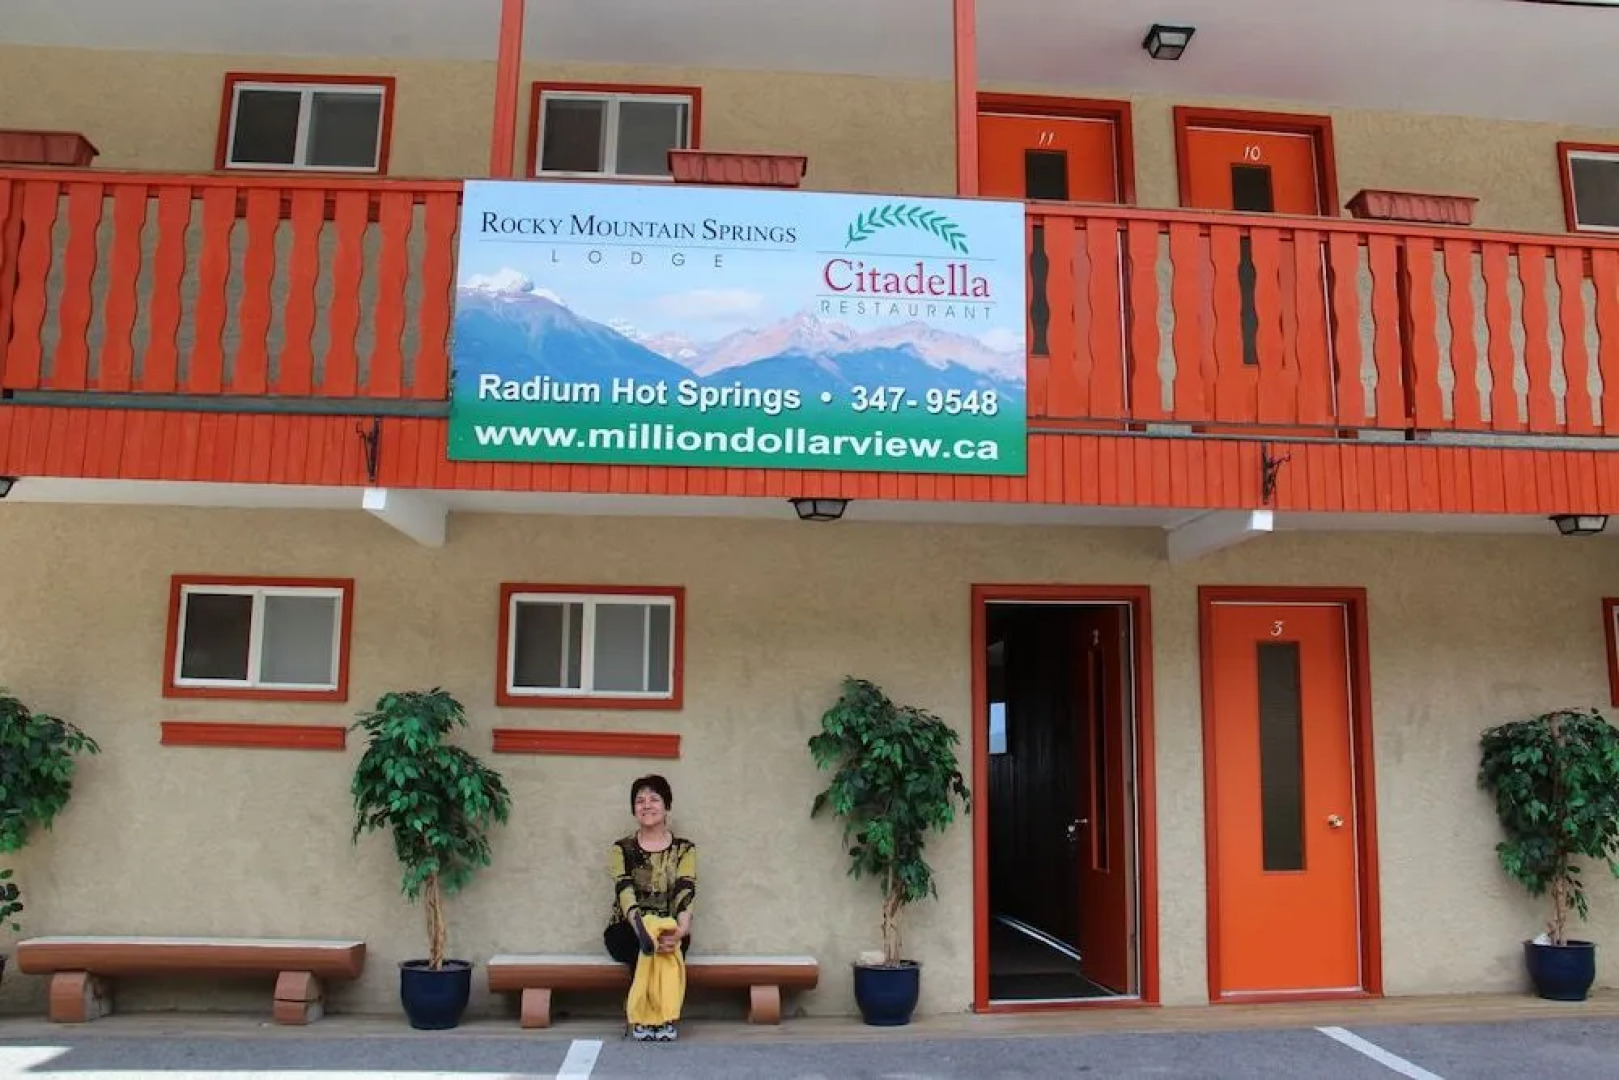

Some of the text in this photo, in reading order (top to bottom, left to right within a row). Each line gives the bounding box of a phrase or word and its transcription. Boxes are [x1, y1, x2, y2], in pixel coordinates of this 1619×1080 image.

[1243, 145, 1261, 161] 10
[481, 211, 797, 244] ROCKY MOUNTAIN SPRINGS
[551, 250, 723, 268] LODGE
[824, 258, 991, 297] Citadella
[820, 299, 992, 319] RESTAURANT
[478, 373, 600, 402] Radium
[611, 377, 668, 406] Hot
[677, 379, 801, 415] Springs
[475, 422, 1000, 461] www.milliondollarview.ca
[1270, 620, 1283, 637] 3
